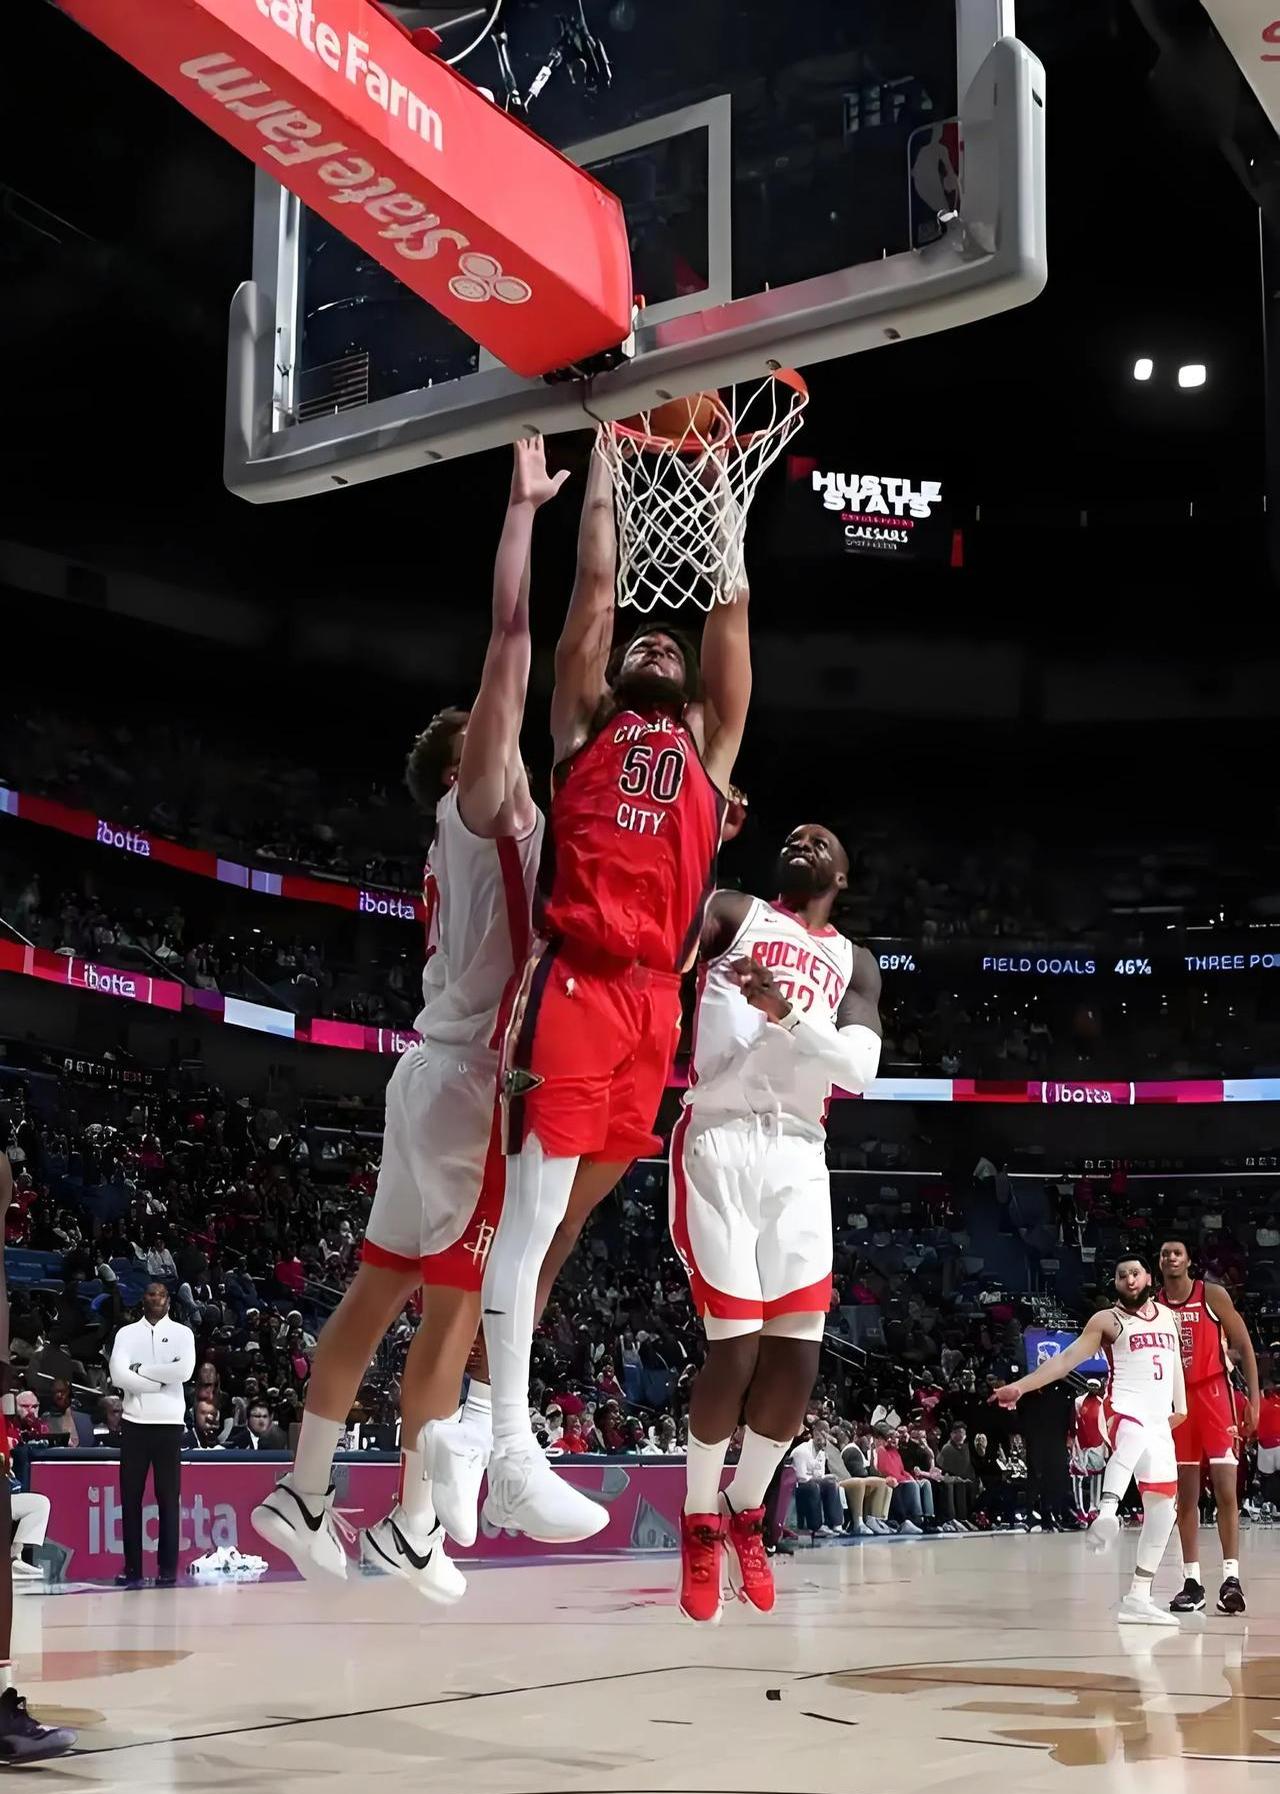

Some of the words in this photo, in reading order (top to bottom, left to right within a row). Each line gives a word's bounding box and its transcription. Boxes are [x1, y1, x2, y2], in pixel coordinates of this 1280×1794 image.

[254, 0, 342, 72] ate
[345, 31, 443, 152] Farm
[179, 52, 349, 167] Farm
[317, 157, 471, 261] State
[812, 470, 942, 502] HUSTLE
[823, 489, 931, 518] STATS
[619, 745, 685, 803] 50
[616, 803, 666, 835] CITY
[97, 819, 150, 856] ibotta
[359, 891, 415, 920] ibotta
[751, 940, 845, 1009] ROCKETS
[982, 957, 1031, 972] FIELD
[1114, 958, 1152, 975] 46%
[1184, 955, 1245, 971] THREE
[1152, 1354, 1163, 1381] 5
